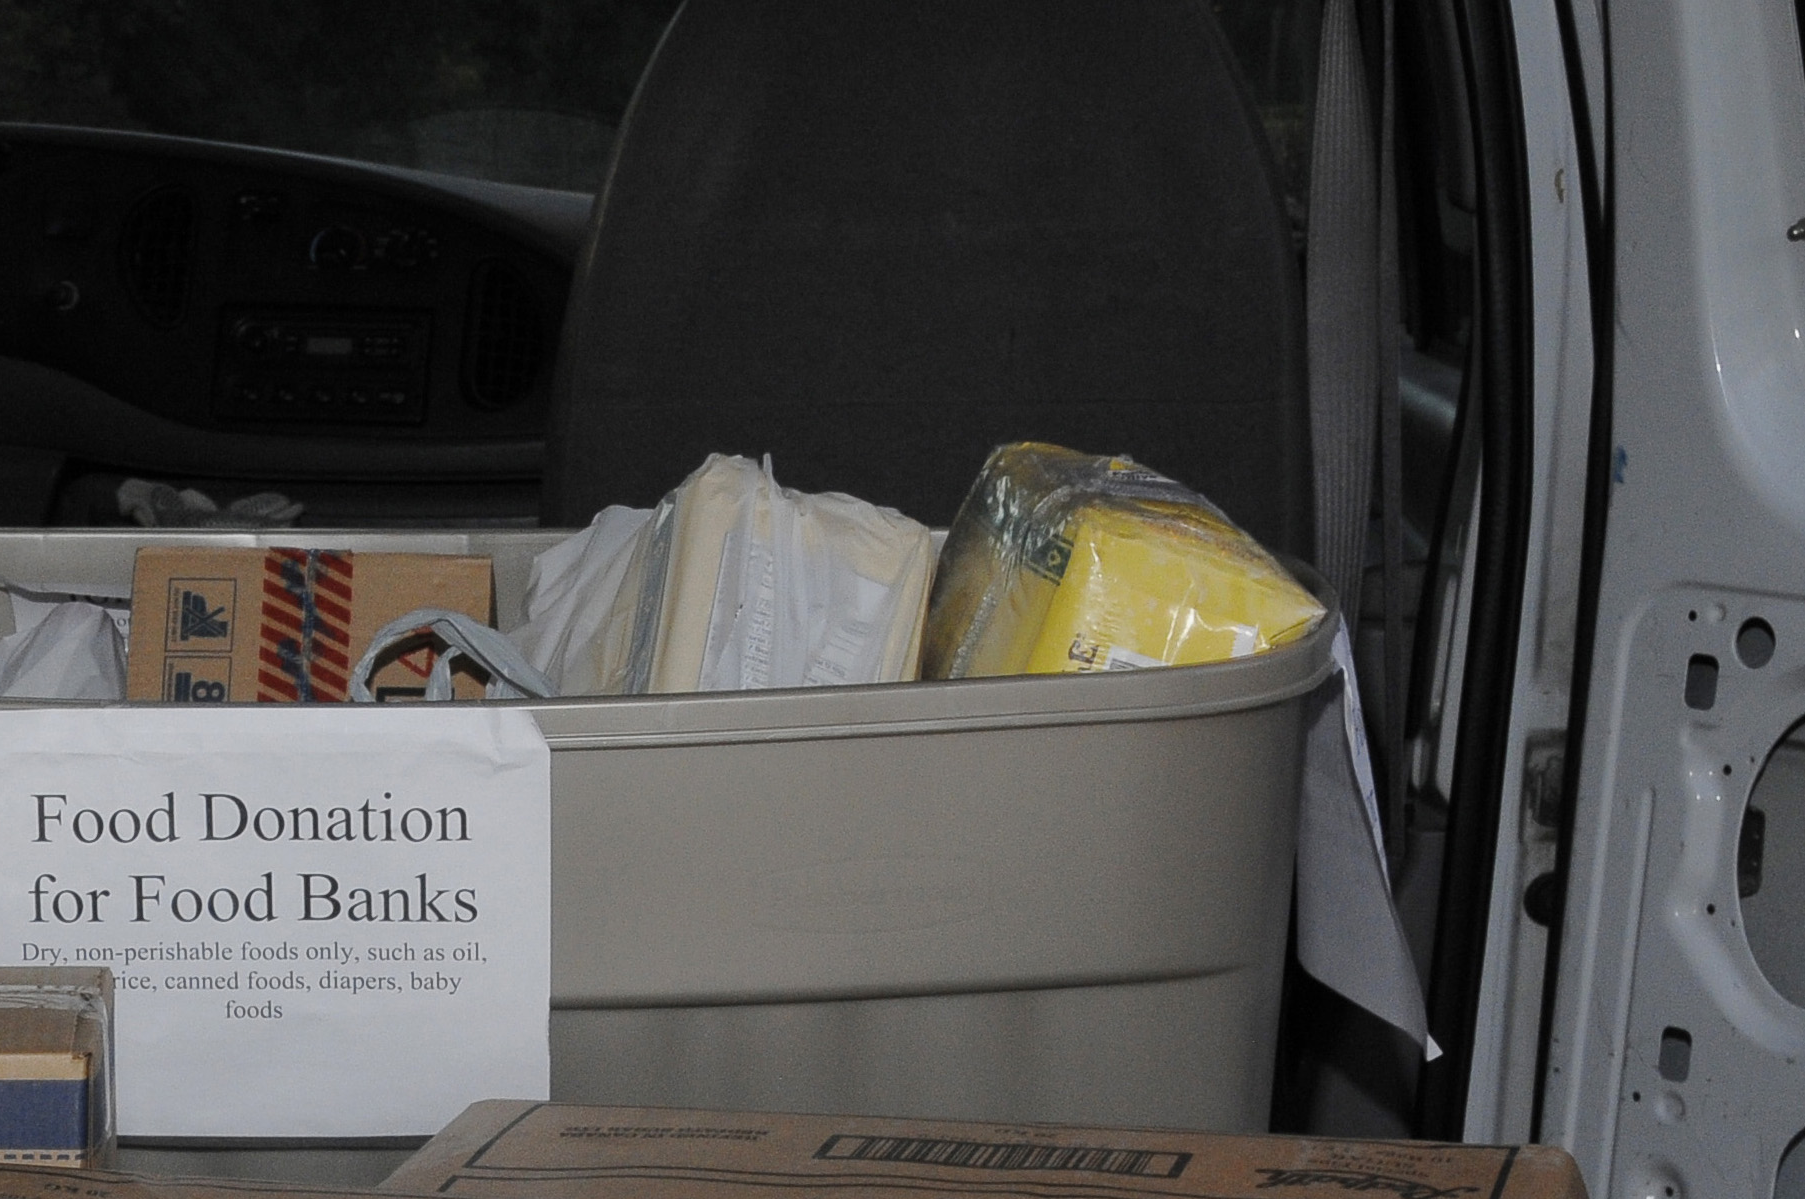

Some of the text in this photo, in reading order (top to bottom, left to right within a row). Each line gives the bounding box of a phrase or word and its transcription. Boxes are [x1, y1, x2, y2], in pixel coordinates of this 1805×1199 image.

[31, 792, 472, 844] Food Donation
[28, 872, 479, 923] for Food Banks
[21, 941, 488, 966] Dry, non-perishable foods only, such as oil,
[164, 971, 239, 990] canned
[248, 971, 311, 992] foods,
[318, 972, 403, 996] diapers,
[409, 971, 462, 996] baby
[225, 1000, 283, 1019] foods
